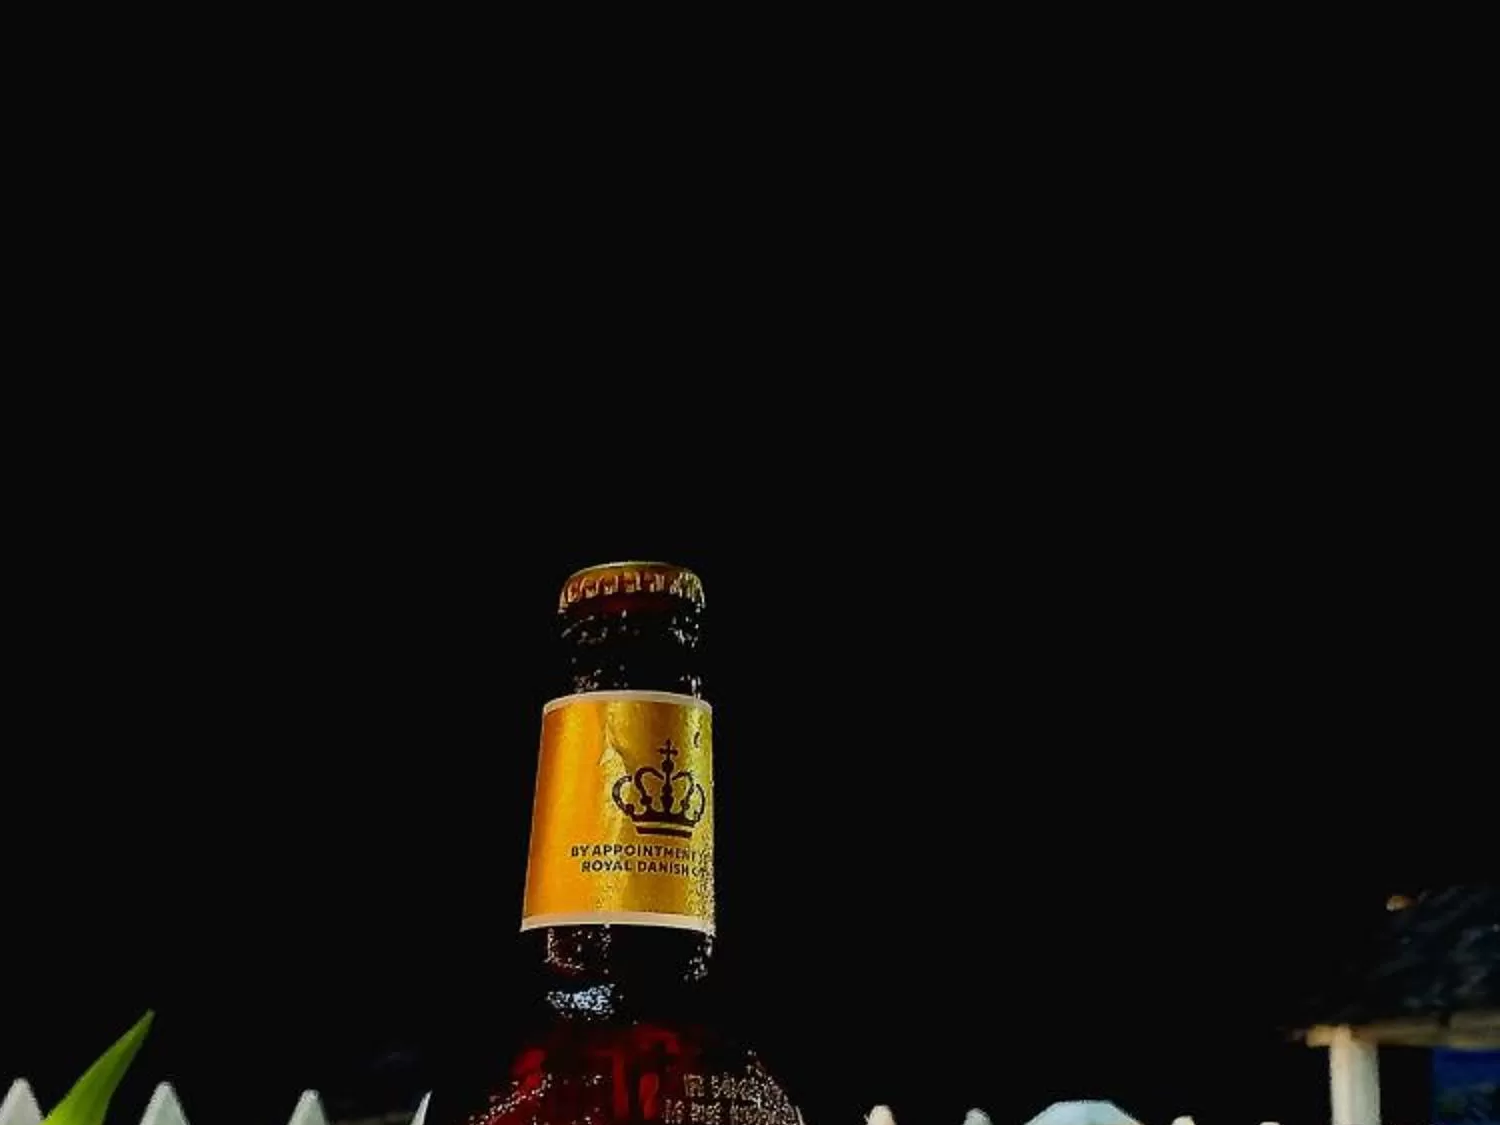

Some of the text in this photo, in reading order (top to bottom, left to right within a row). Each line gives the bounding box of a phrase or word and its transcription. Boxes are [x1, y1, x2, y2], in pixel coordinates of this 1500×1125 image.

[571, 845, 589, 857] BY
[591, 844, 696, 861] APPOINTMENT
[581, 860, 632, 873] ROYAL
[637, 861, 689, 877] DANISH
